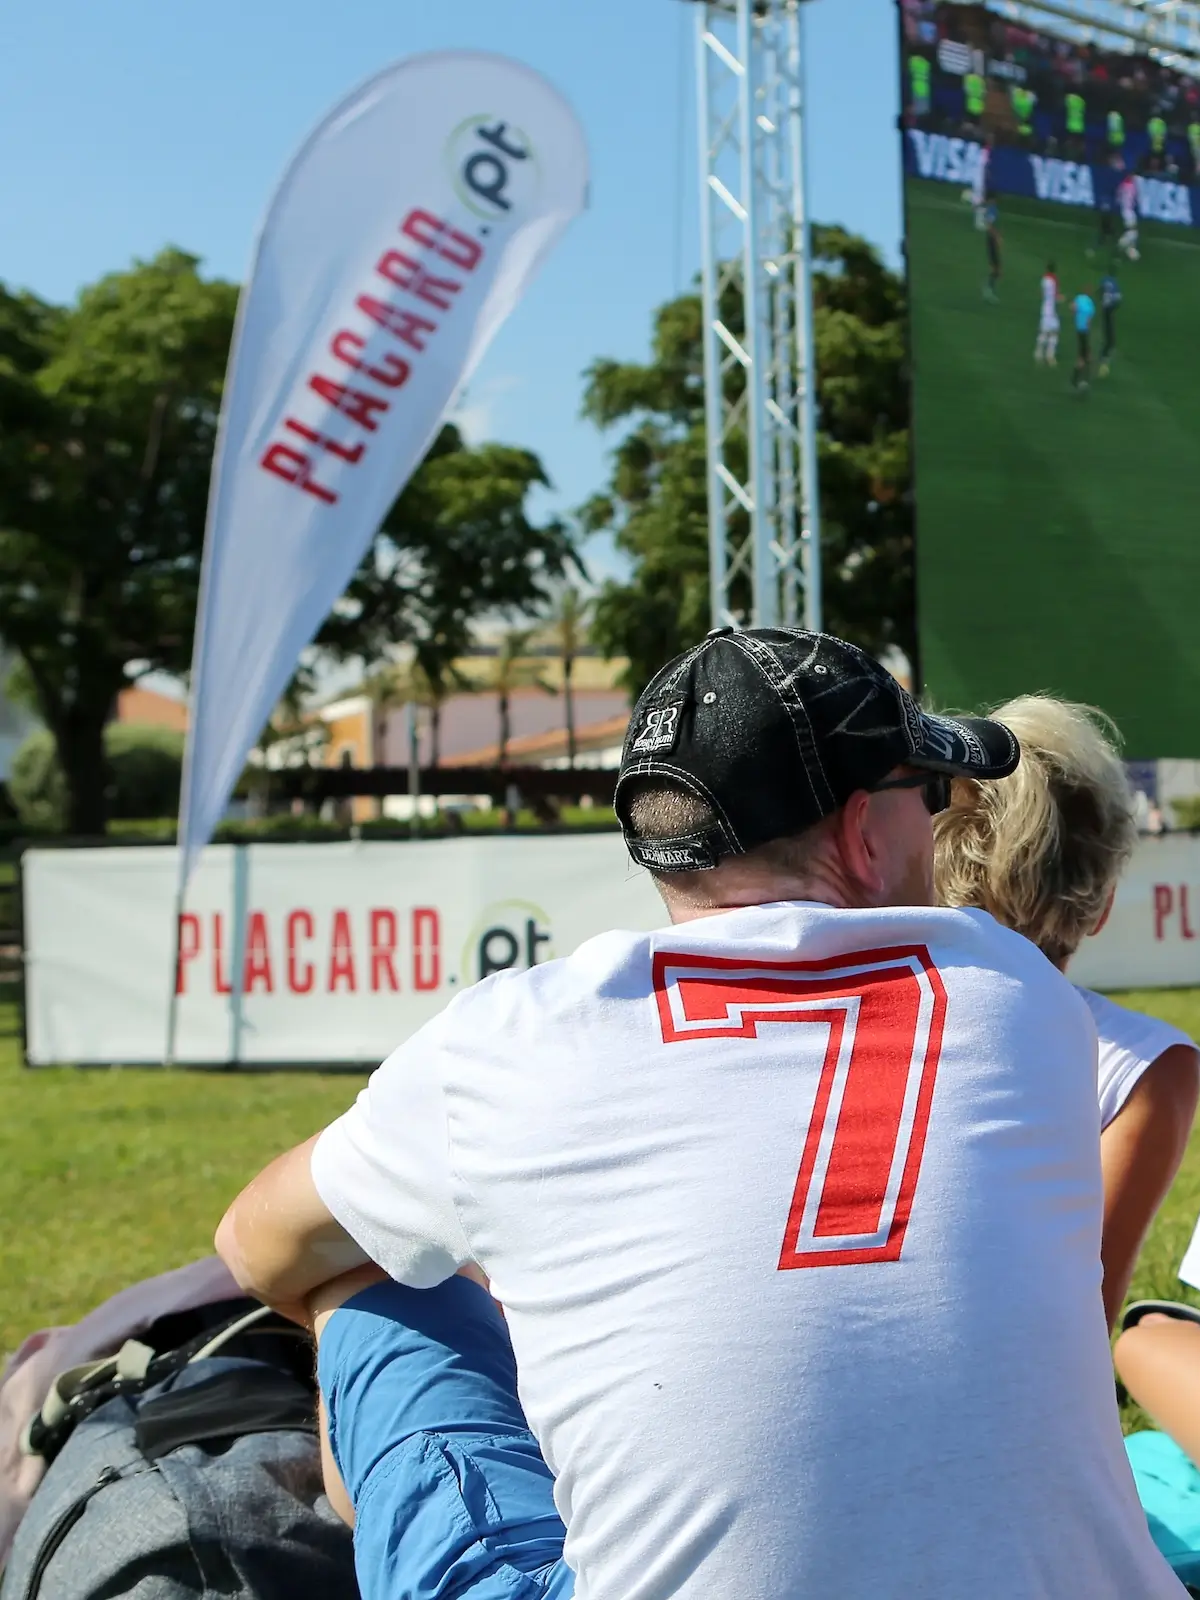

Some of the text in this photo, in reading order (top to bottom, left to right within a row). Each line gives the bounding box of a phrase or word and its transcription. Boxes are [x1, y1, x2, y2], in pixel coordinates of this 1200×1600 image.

[908, 128, 984, 184] VISA
[1028, 153, 1095, 206] VISA
[1132, 174, 1192, 226] VISA
[652, 943, 948, 1271] 7
